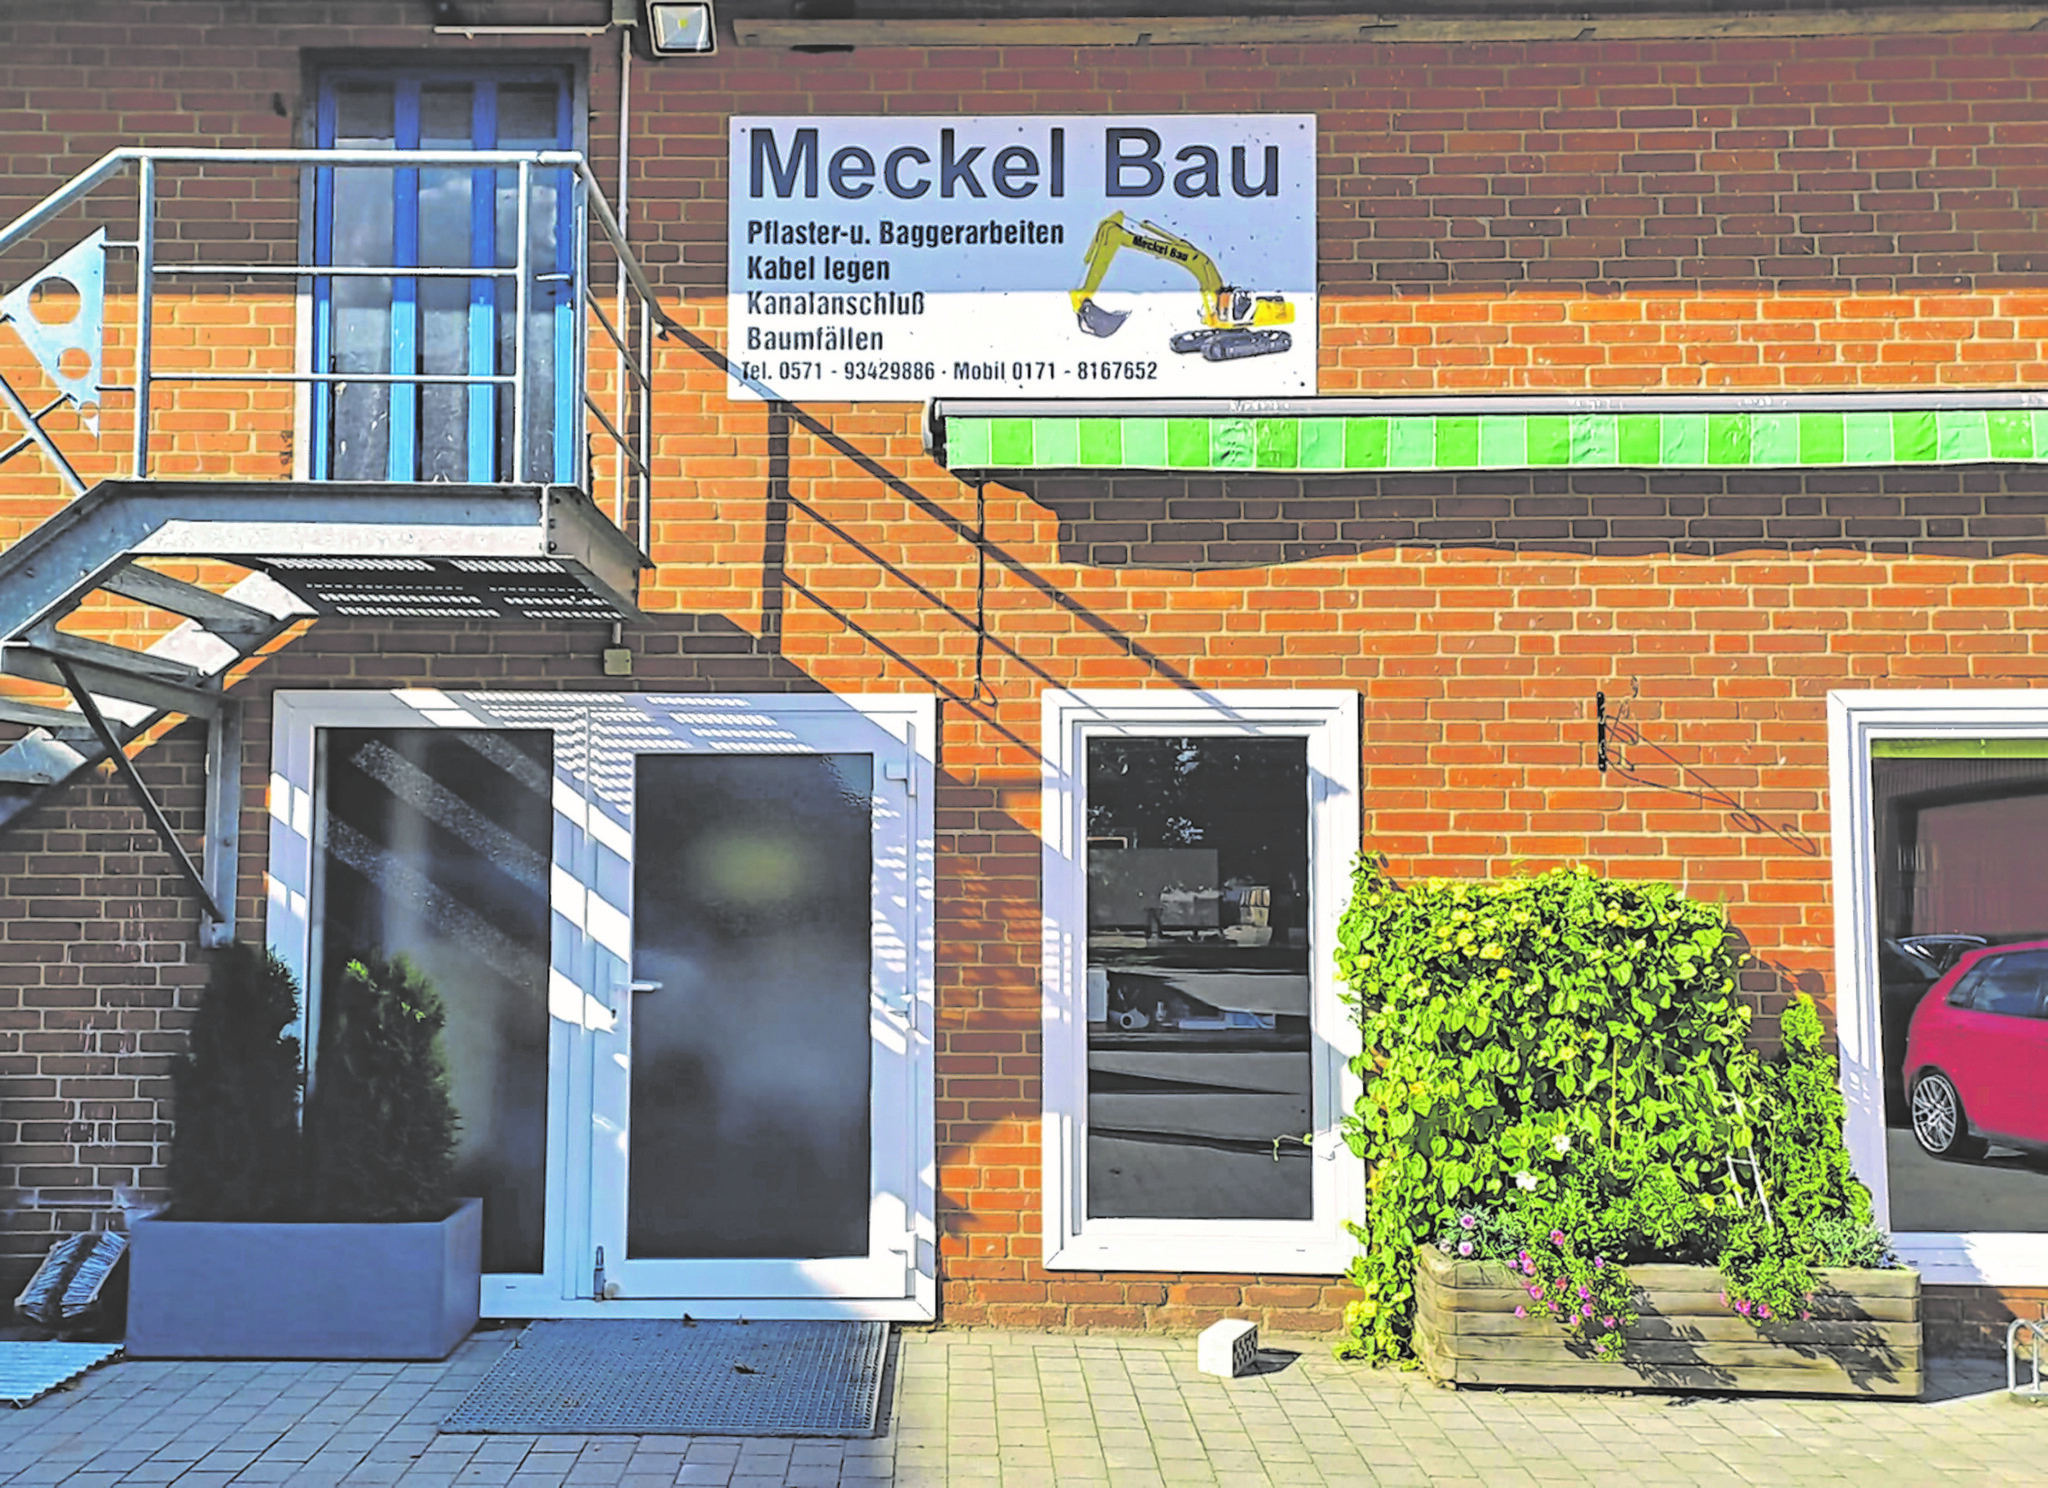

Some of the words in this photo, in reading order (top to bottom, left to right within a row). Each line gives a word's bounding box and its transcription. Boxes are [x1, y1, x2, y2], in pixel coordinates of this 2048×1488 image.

[749, 127, 1065, 200] Meckel
[1104, 127, 1279, 200] Bau
[879, 219, 1064, 248] Baggerarbeiten
[1132, 235, 1168, 256] Meckel
[1169, 247, 1189, 261] Bau
[747, 255, 815, 280] Kabel
[824, 255, 890, 283] legen
[747, 291, 924, 315] Kanalanschluß
[747, 326, 883, 351] Baumfällen
[741, 361, 772, 380] Tel.
[779, 361, 821, 380] 0571
[844, 361, 935, 380] 93429886
[953, 361, 1005, 380] Mobil
[1012, 361, 1055, 380] 0171
[1077, 361, 1158, 380] 8167652
